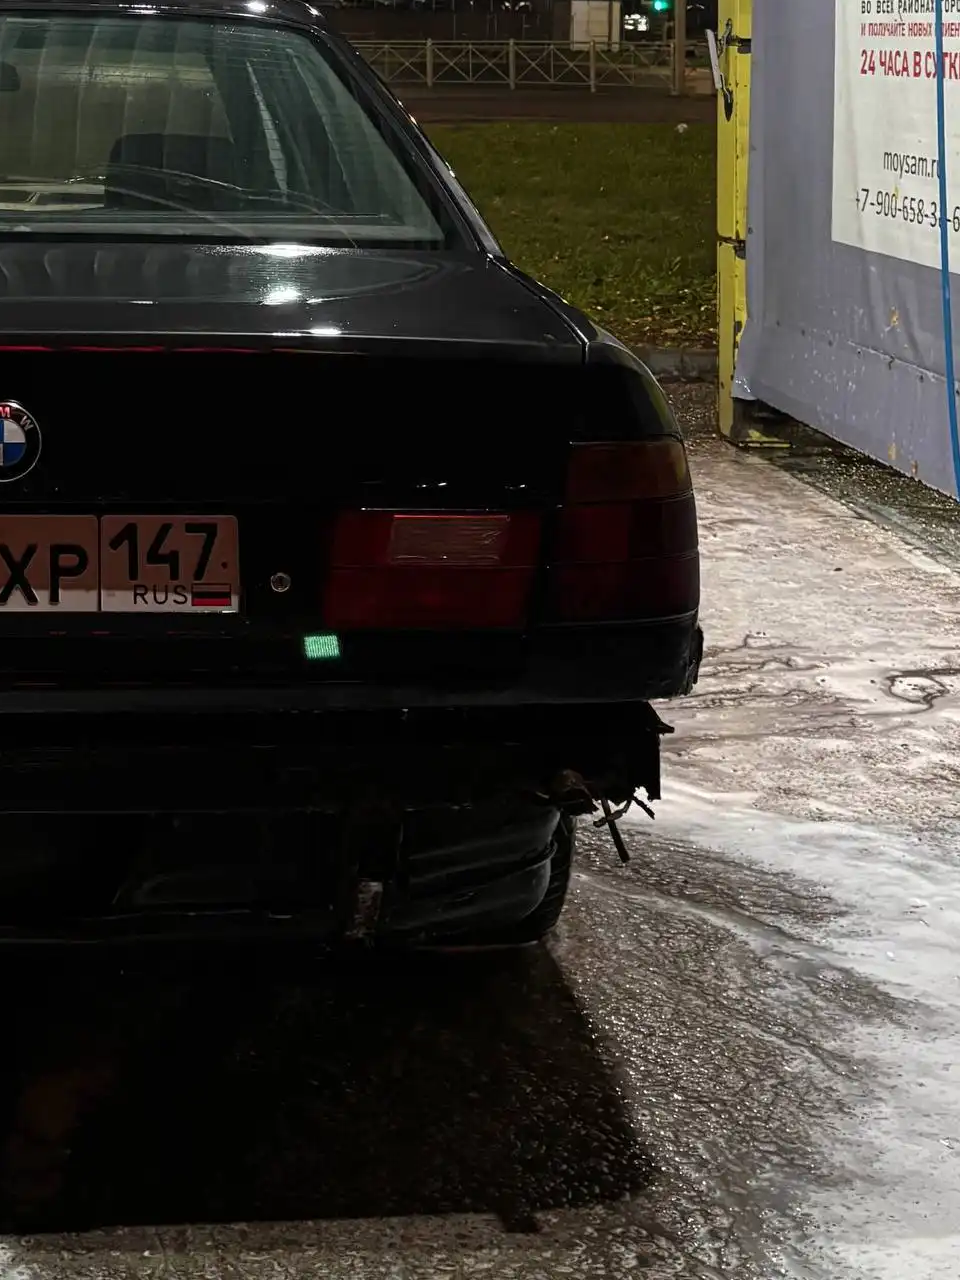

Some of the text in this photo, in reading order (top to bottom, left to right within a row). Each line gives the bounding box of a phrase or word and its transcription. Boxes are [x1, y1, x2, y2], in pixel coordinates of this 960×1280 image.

[861, 0, 872, 14] ВО
[876, 0, 894, 14] ВСЕХ
[861, 23, 866, 37] И
[868, 20, 906, 38] ПОЛУЧАЙТЕ
[907, 22, 933, 38] НОВЫХ
[860, 49, 876, 76] 24
[878, 50, 910, 78] ЧАСА
[912, 51, 922, 79] В
[856, 188, 960, 232] +7-900-658-3-6
[109, 523, 219, 582] 147
[133, 584, 189, 606] RUS
